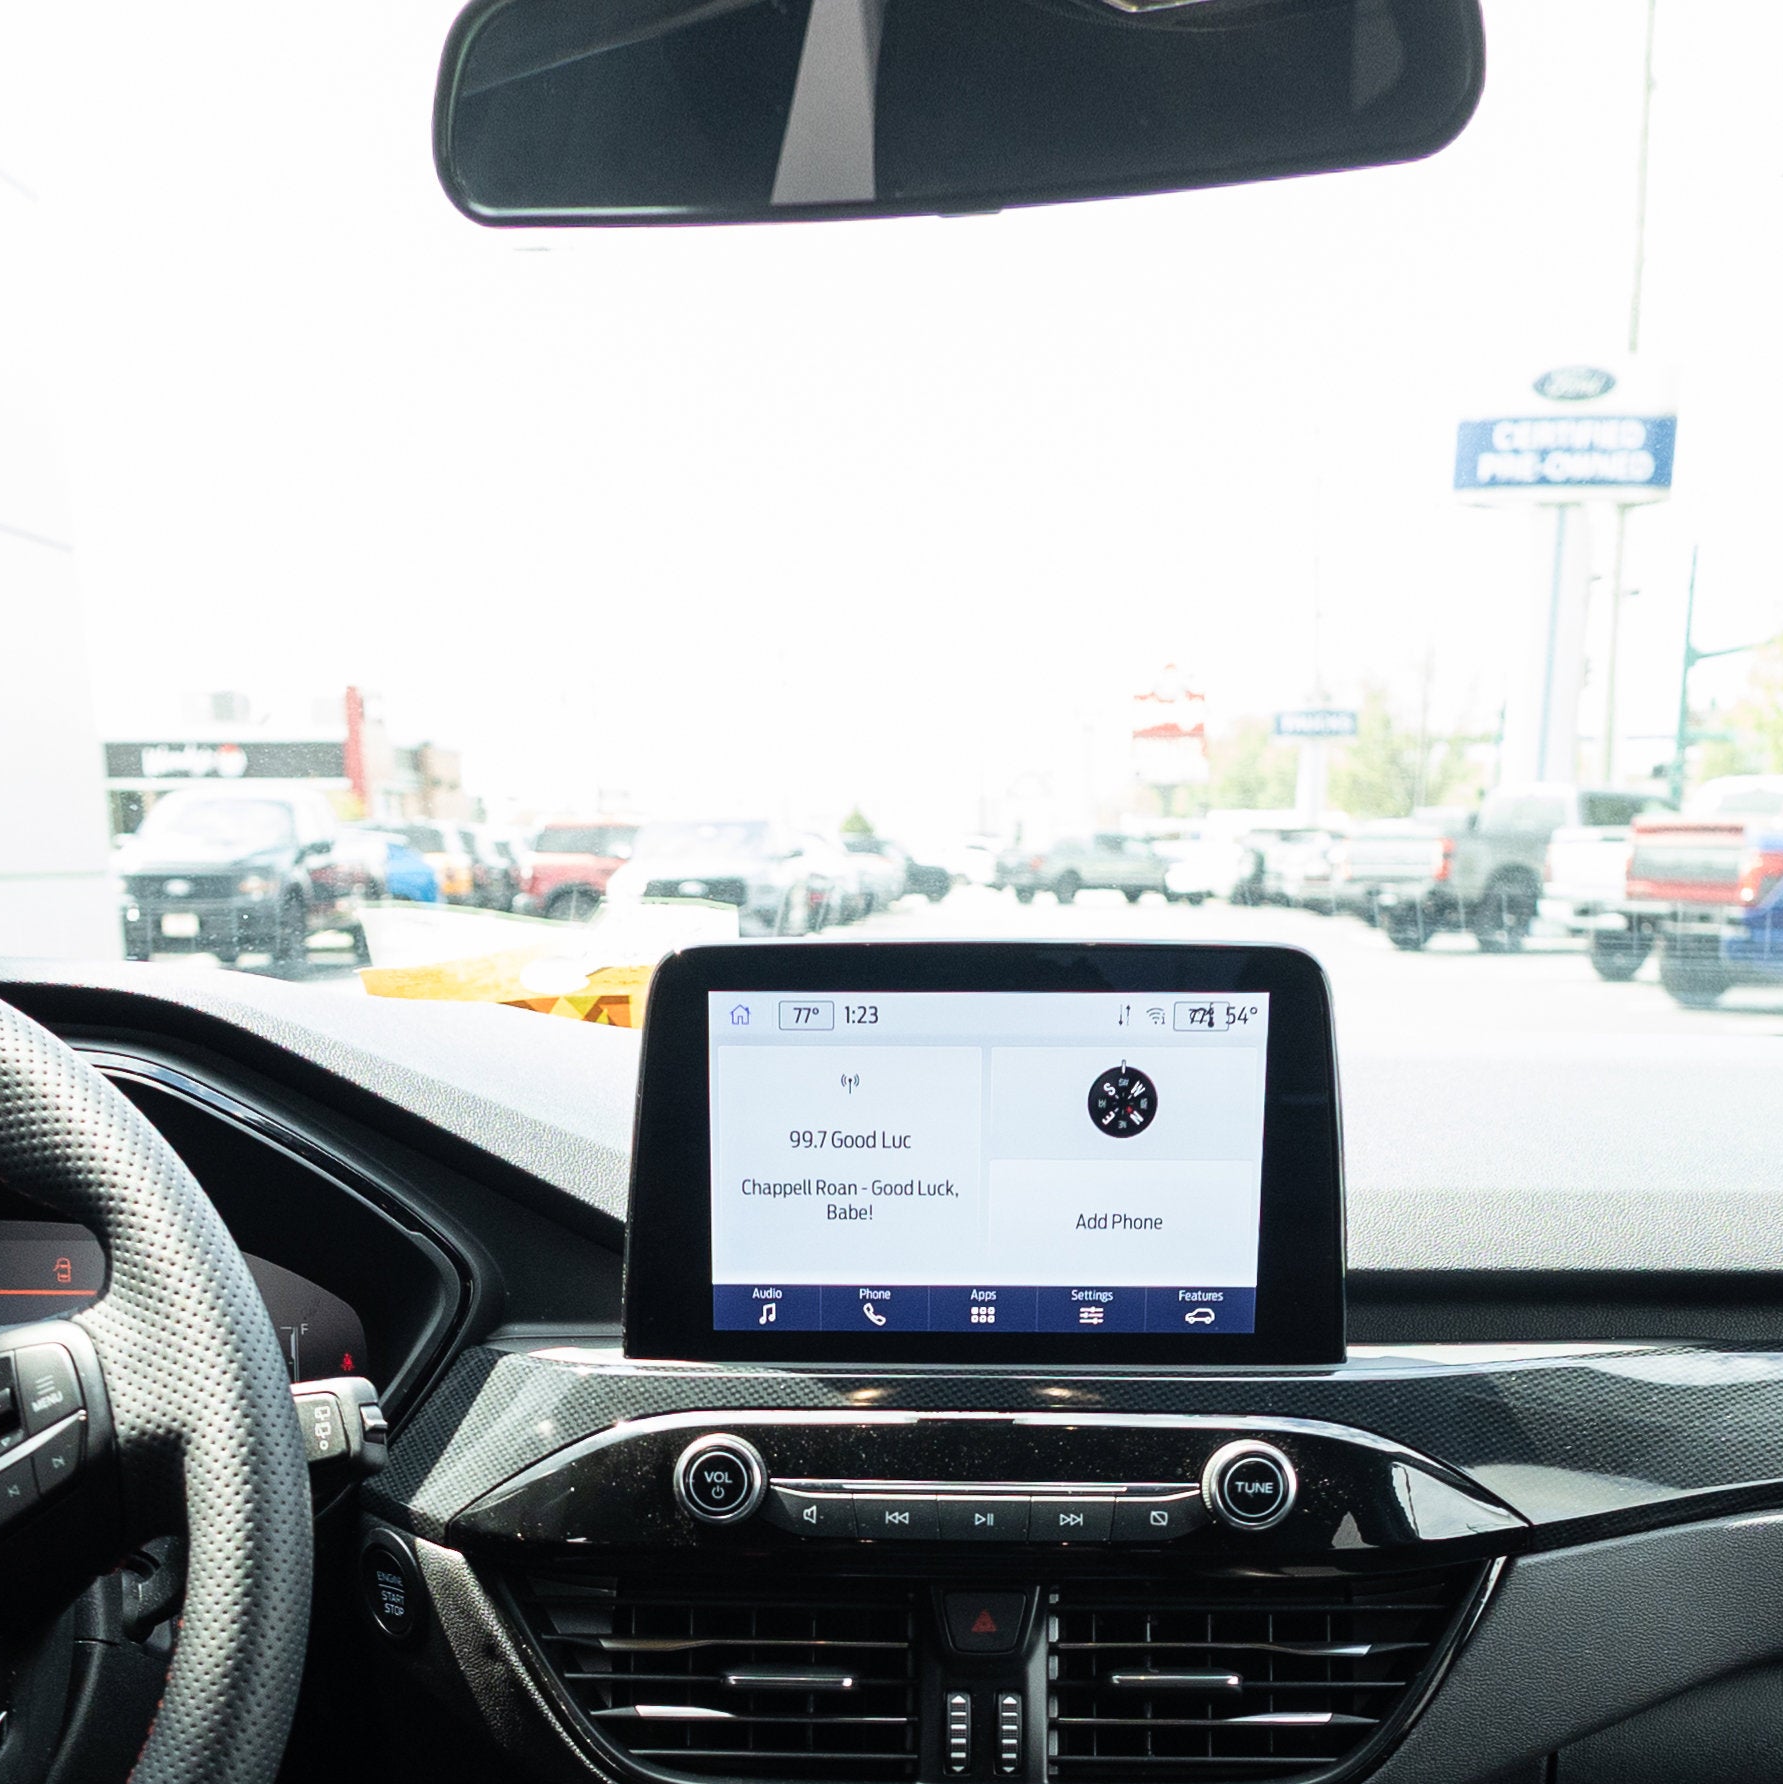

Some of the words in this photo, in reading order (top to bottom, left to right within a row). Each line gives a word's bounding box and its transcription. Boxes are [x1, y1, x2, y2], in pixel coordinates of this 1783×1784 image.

[843, 1005, 879, 1025] 1:23
[1225, 1006, 1258, 1025] 54°
[1103, 1082, 1116, 1096] S
[1130, 1080, 1146, 1098] W
[1102, 1111, 1116, 1125] E
[1129, 1110, 1144, 1125] N
[788, 1130, 828, 1149] 99.7
[831, 1130, 877, 1150] Good
[882, 1131, 912, 1150] Luc
[741, 1178, 812, 1199] Chappell
[815, 1179, 858, 1196] Roan
[871, 1179, 914, 1197] Good
[918, 1180, 959, 1198] Luck,
[826, 1203, 873, 1221] Babe!
[1075, 1213, 1108, 1230] Add
[1111, 1213, 1163, 1230] Phone
[752, 1287, 783, 1300] Audio
[859, 1288, 891, 1300] Phone
[970, 1288, 997, 1303] Apps
[1071, 1289, 1114, 1303] Settings
[1178, 1289, 1224, 1302] Features
[300, 1323, 310, 1335] F
[31, 1391, 64, 1413] MENU
[704, 1471, 733, 1484] VOL
[1234, 1481, 1274, 1495] TUNE
[376, 1570, 403, 1587] ENGINE
[381, 1590, 405, 1606] START
[384, 1603, 405, 1617] STOP
